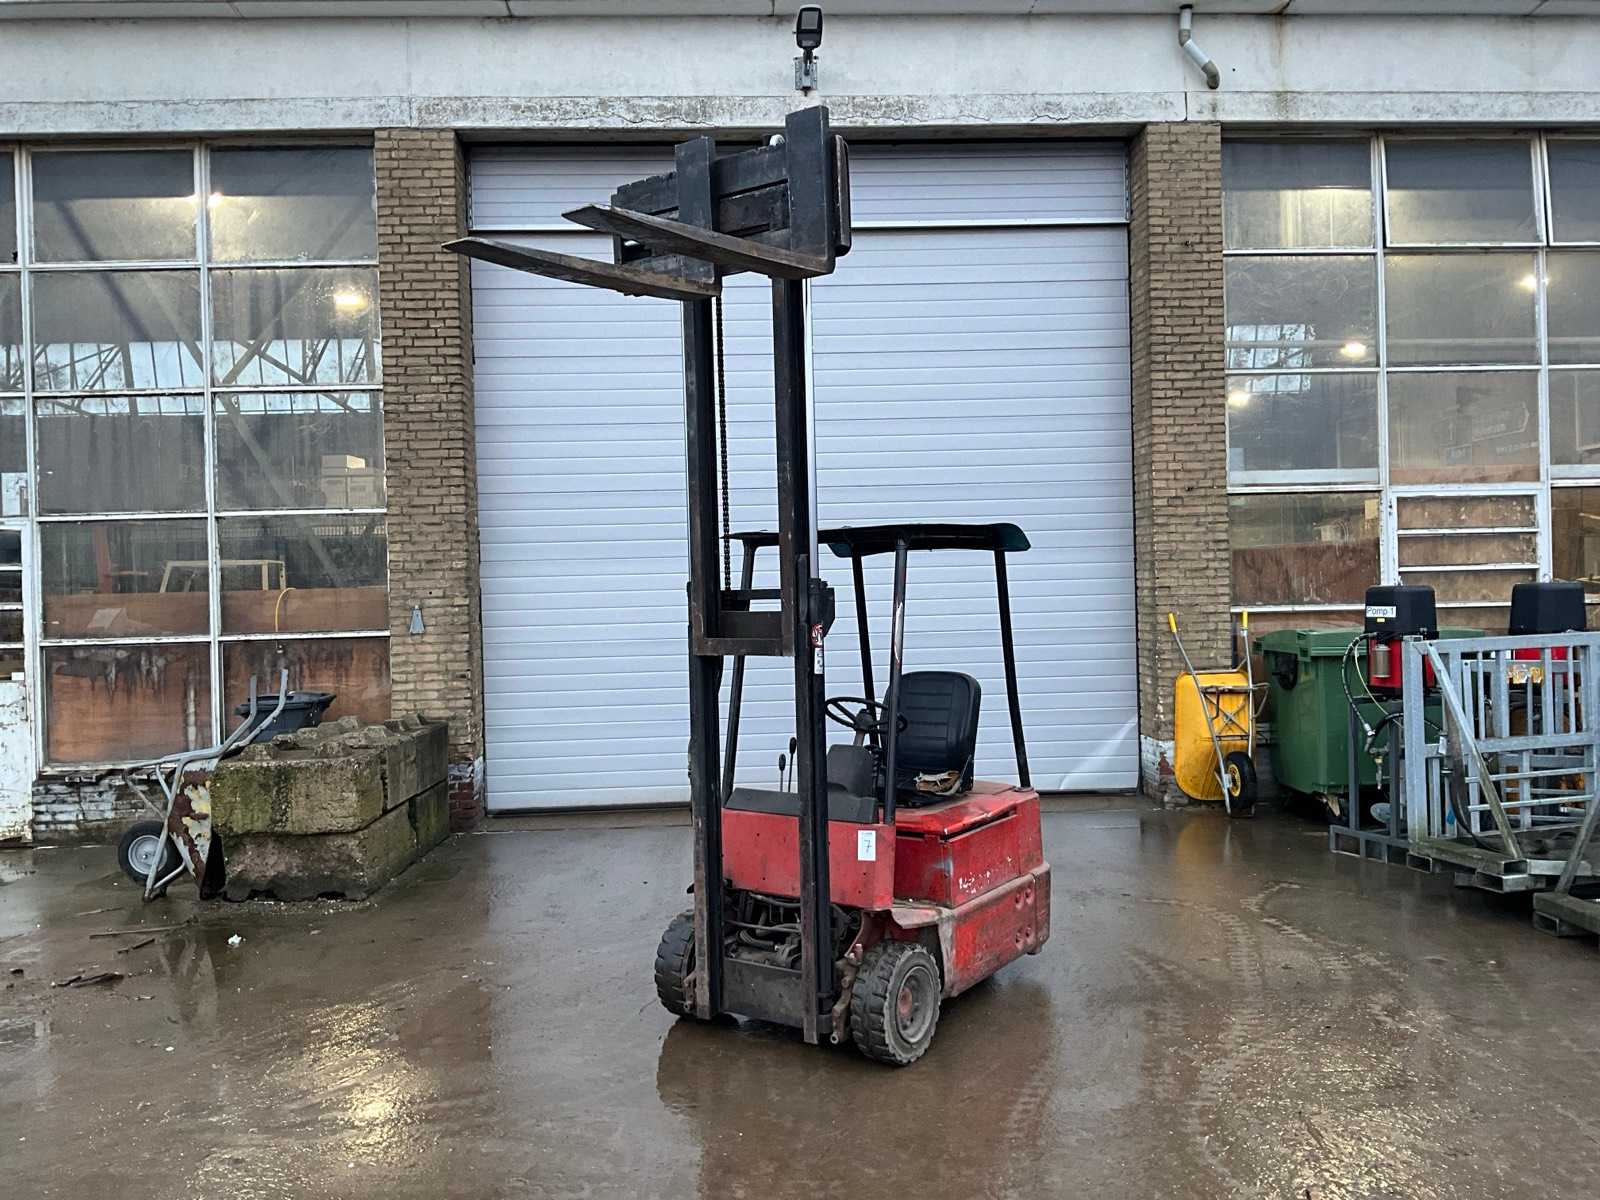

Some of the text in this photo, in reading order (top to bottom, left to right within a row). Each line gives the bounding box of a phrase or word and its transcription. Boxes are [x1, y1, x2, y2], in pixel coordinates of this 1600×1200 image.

[1366, 607, 1394, 616] Pomp 1
[864, 839, 872, 853] 7
